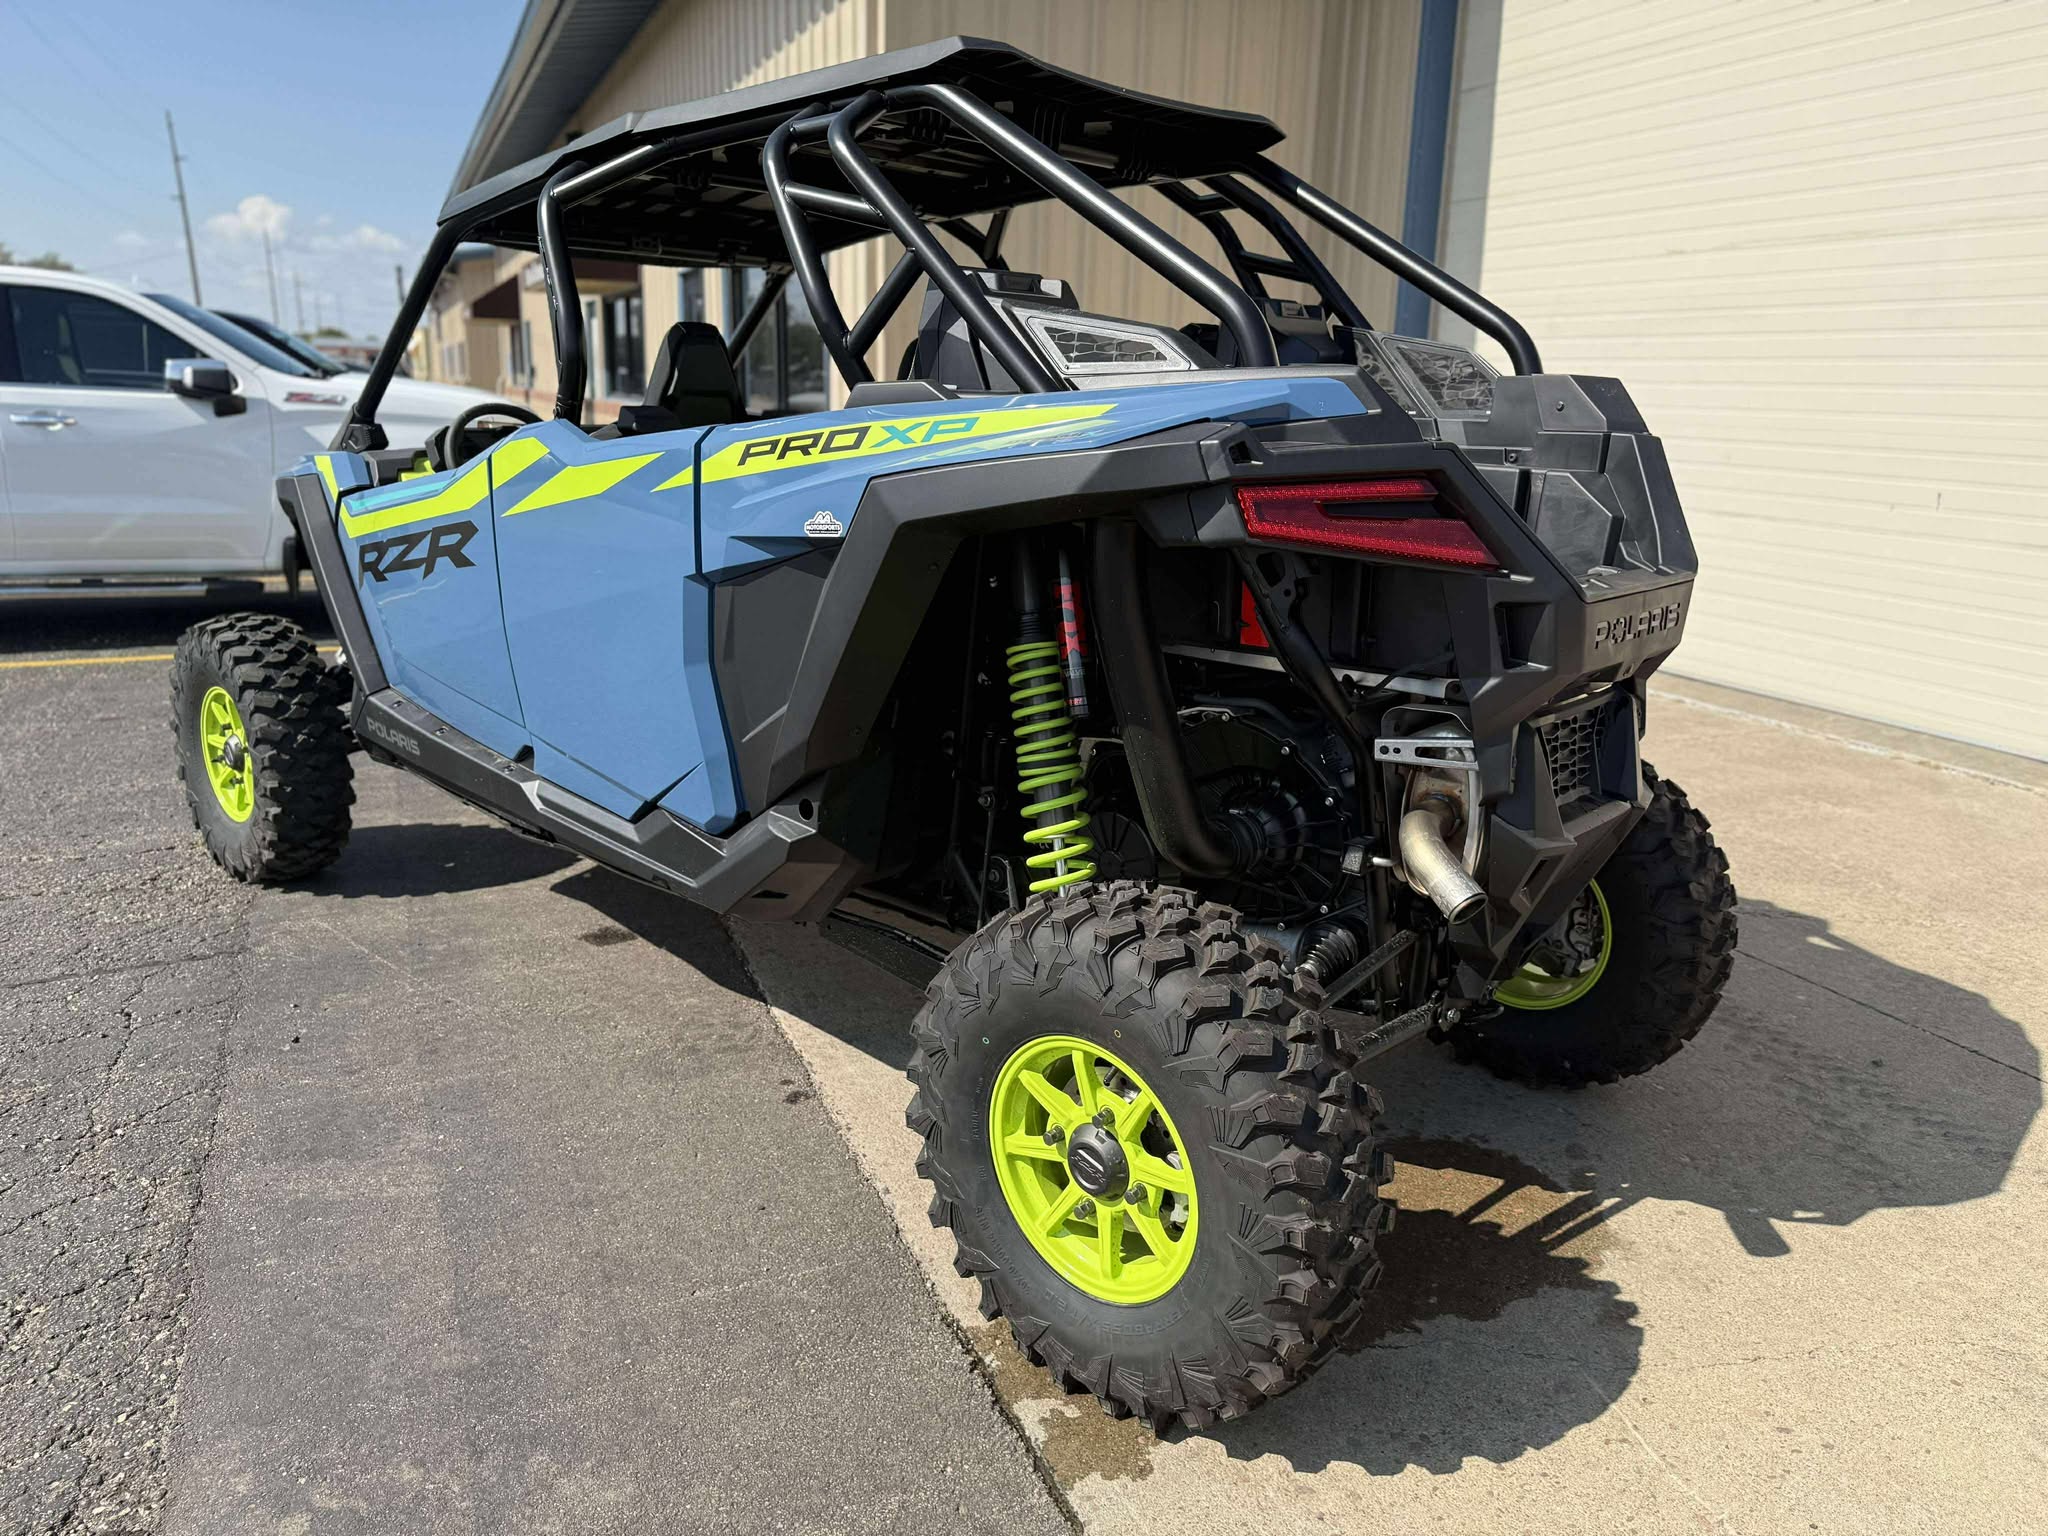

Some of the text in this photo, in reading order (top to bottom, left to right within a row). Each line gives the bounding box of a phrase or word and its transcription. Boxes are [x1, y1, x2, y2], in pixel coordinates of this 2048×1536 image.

[737, 416, 980, 467] PRO XP
[359, 519, 479, 592] RZR
[1594, 602, 1681, 650] POLARIS
[366, 716, 420, 756] POLARIS
